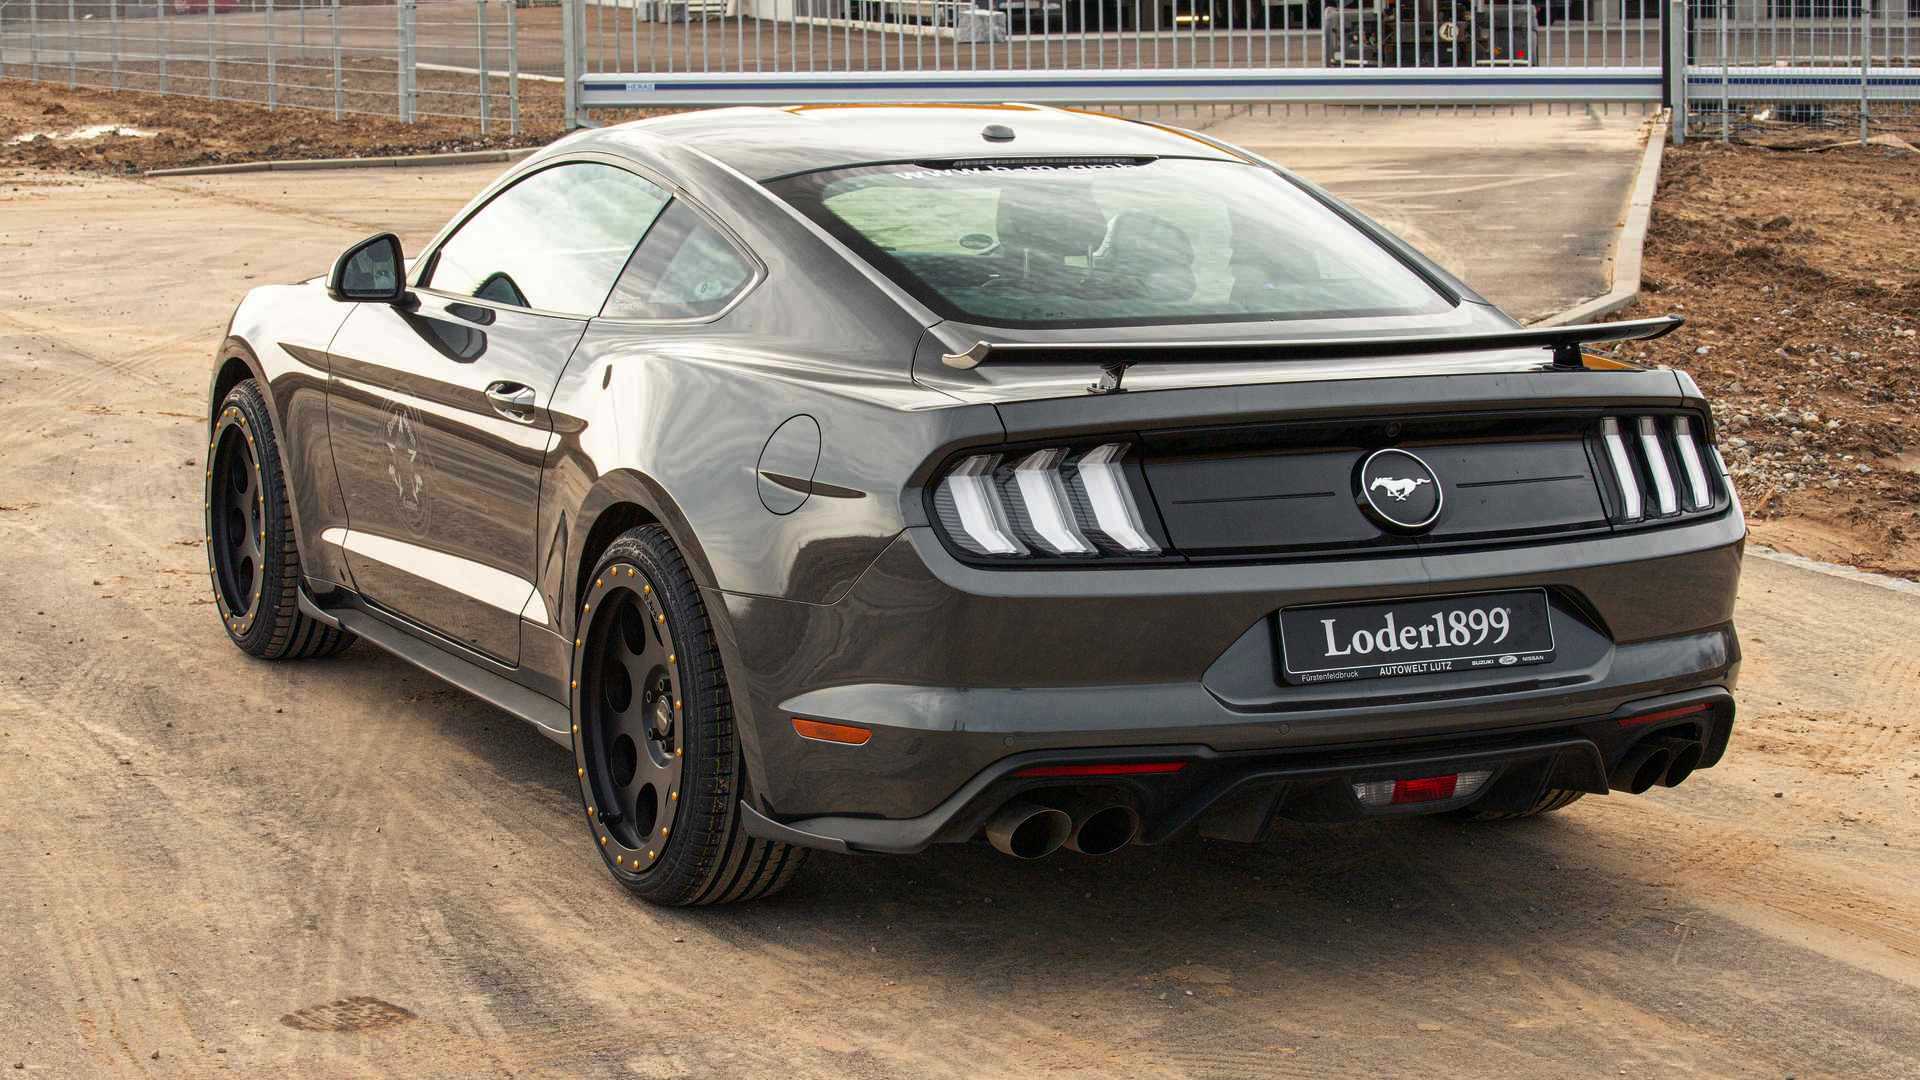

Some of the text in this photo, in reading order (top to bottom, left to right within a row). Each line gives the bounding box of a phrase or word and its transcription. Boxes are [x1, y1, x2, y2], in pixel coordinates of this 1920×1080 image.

[1379, 661, 1452, 676] AUTOWELT LUTZ
[1301, 670, 1359, 682] Fürstenfeldbruck
